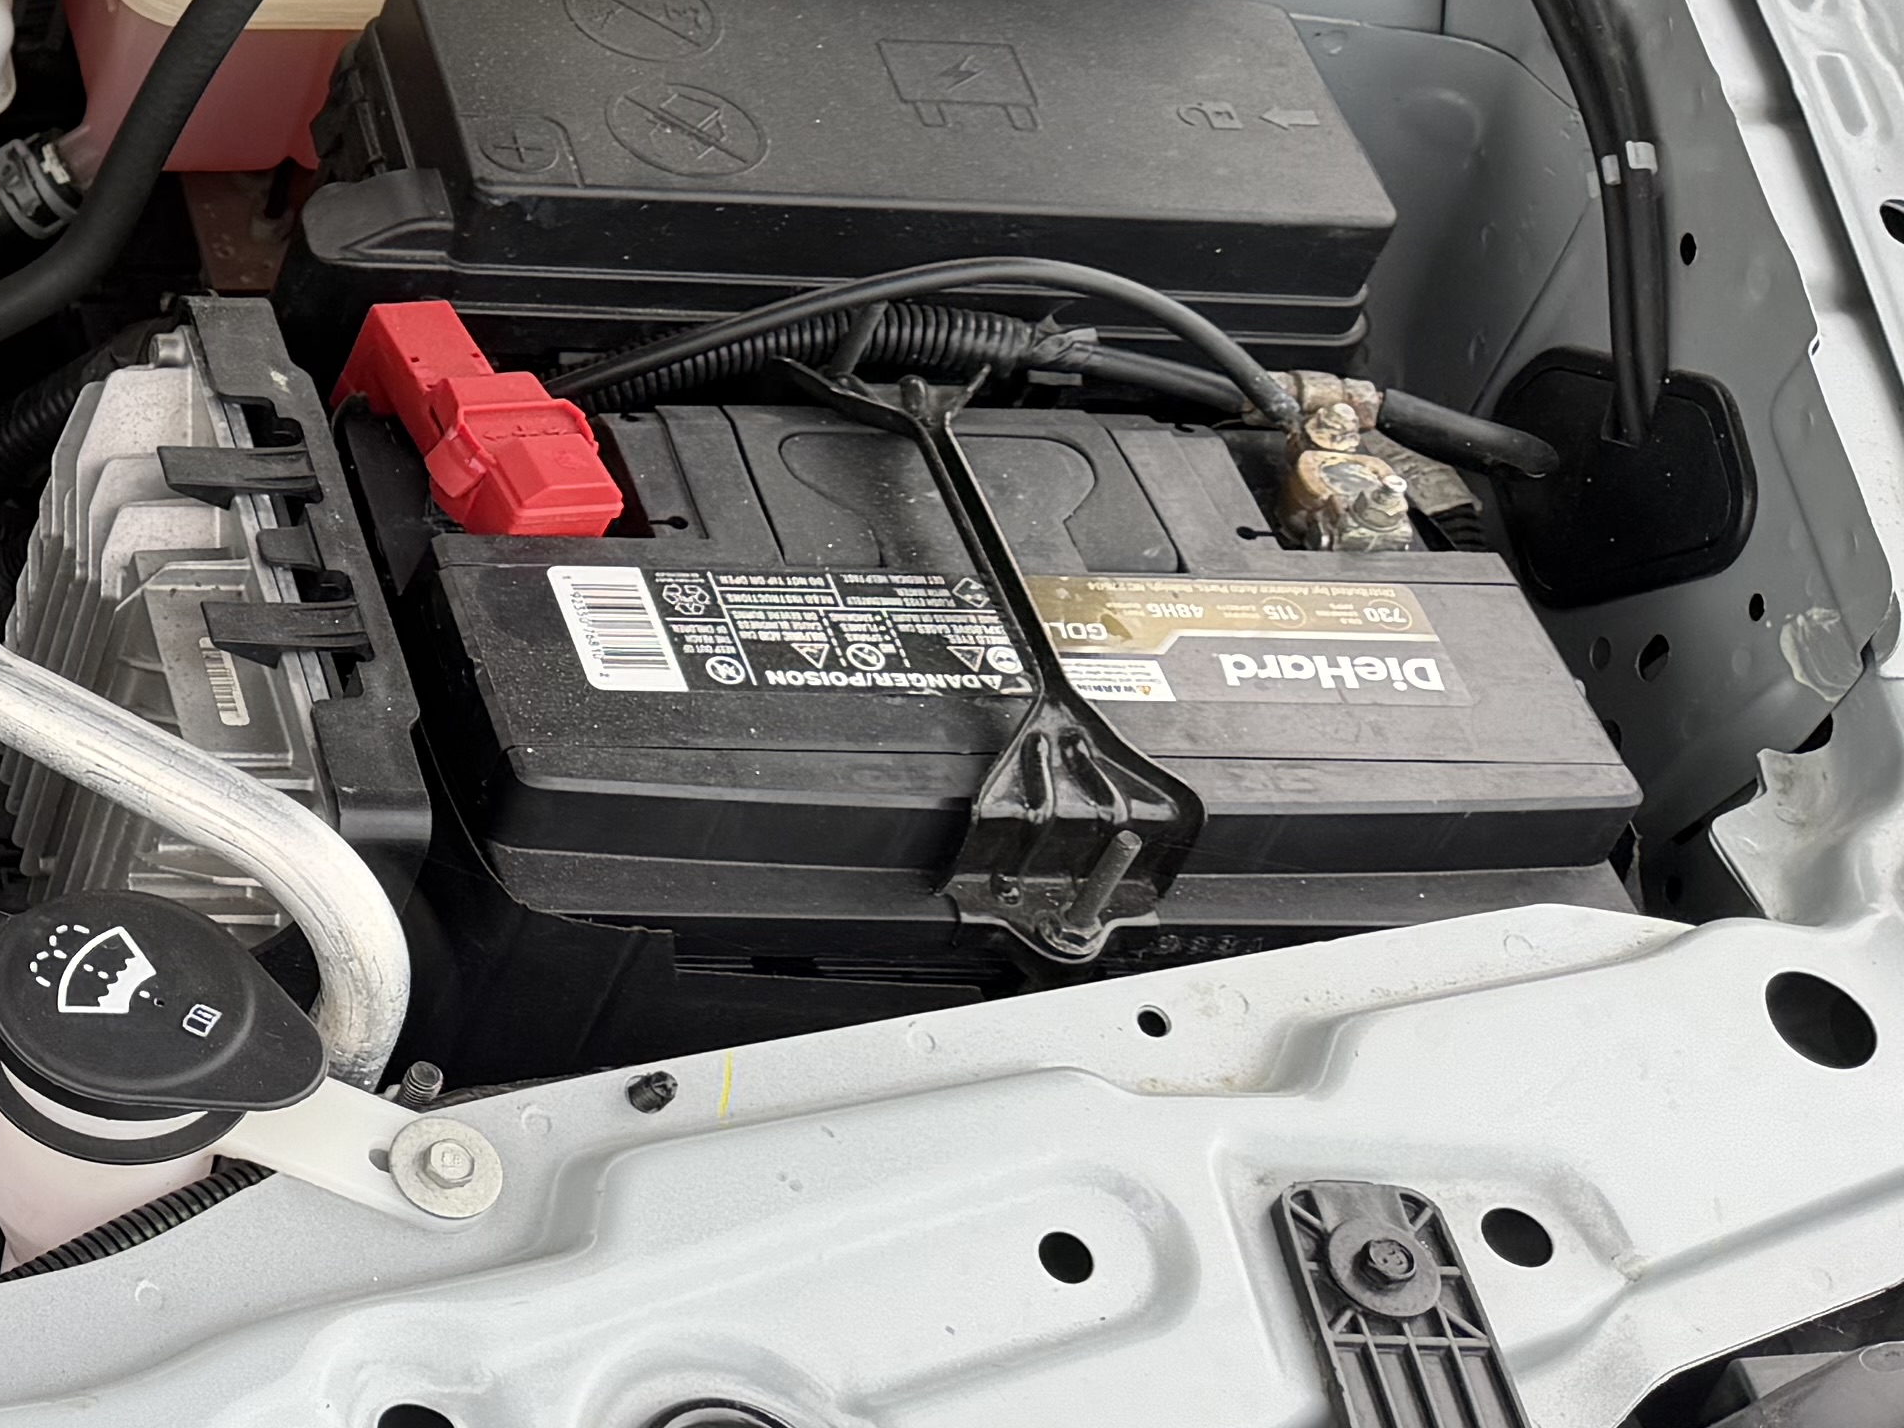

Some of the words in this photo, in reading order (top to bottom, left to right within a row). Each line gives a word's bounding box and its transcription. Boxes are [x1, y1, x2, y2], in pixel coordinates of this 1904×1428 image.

[1229, 583, 1259, 595] Auto
[1330, 586, 1396, 599] Distributed
[1145, 601, 1204, 619] 48H6
[1263, 603, 1300, 622] 115
[1363, 605, 1407, 624] 730
[1044, 622, 1108, 641] GOL
[765, 670, 982, 689] DANGER/POISON
[1218, 653, 1446, 693] DieHard
